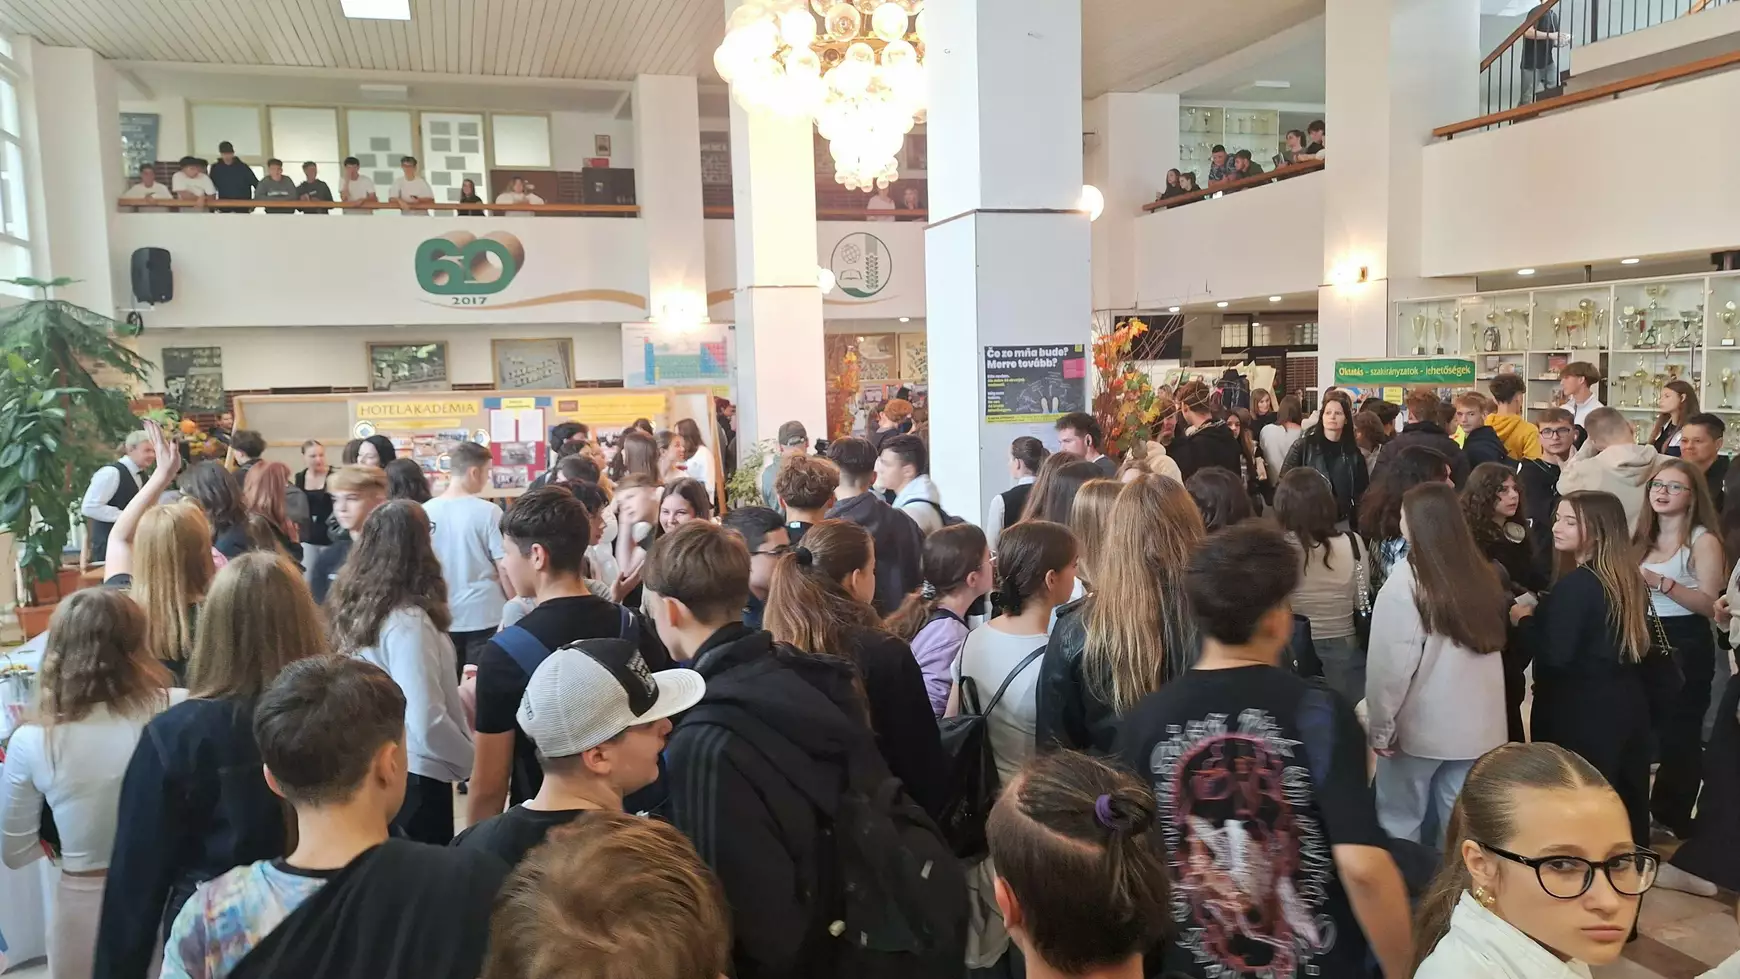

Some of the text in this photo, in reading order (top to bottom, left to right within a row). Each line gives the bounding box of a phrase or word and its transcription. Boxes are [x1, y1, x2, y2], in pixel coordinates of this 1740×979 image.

[415, 231, 524, 295] 60
[452, 296, 488, 305] 2017
[987, 347, 1001, 358] Čo
[1014, 347, 1037, 358] mňa
[1038, 347, 1069, 357] bude?
[987, 358, 1058, 369] Merre tovább?
[1339, 367, 1364, 376] Oktatás
[1370, 366, 1419, 377] szakirányzatok
[1426, 365, 1470, 376] lehetőségek
